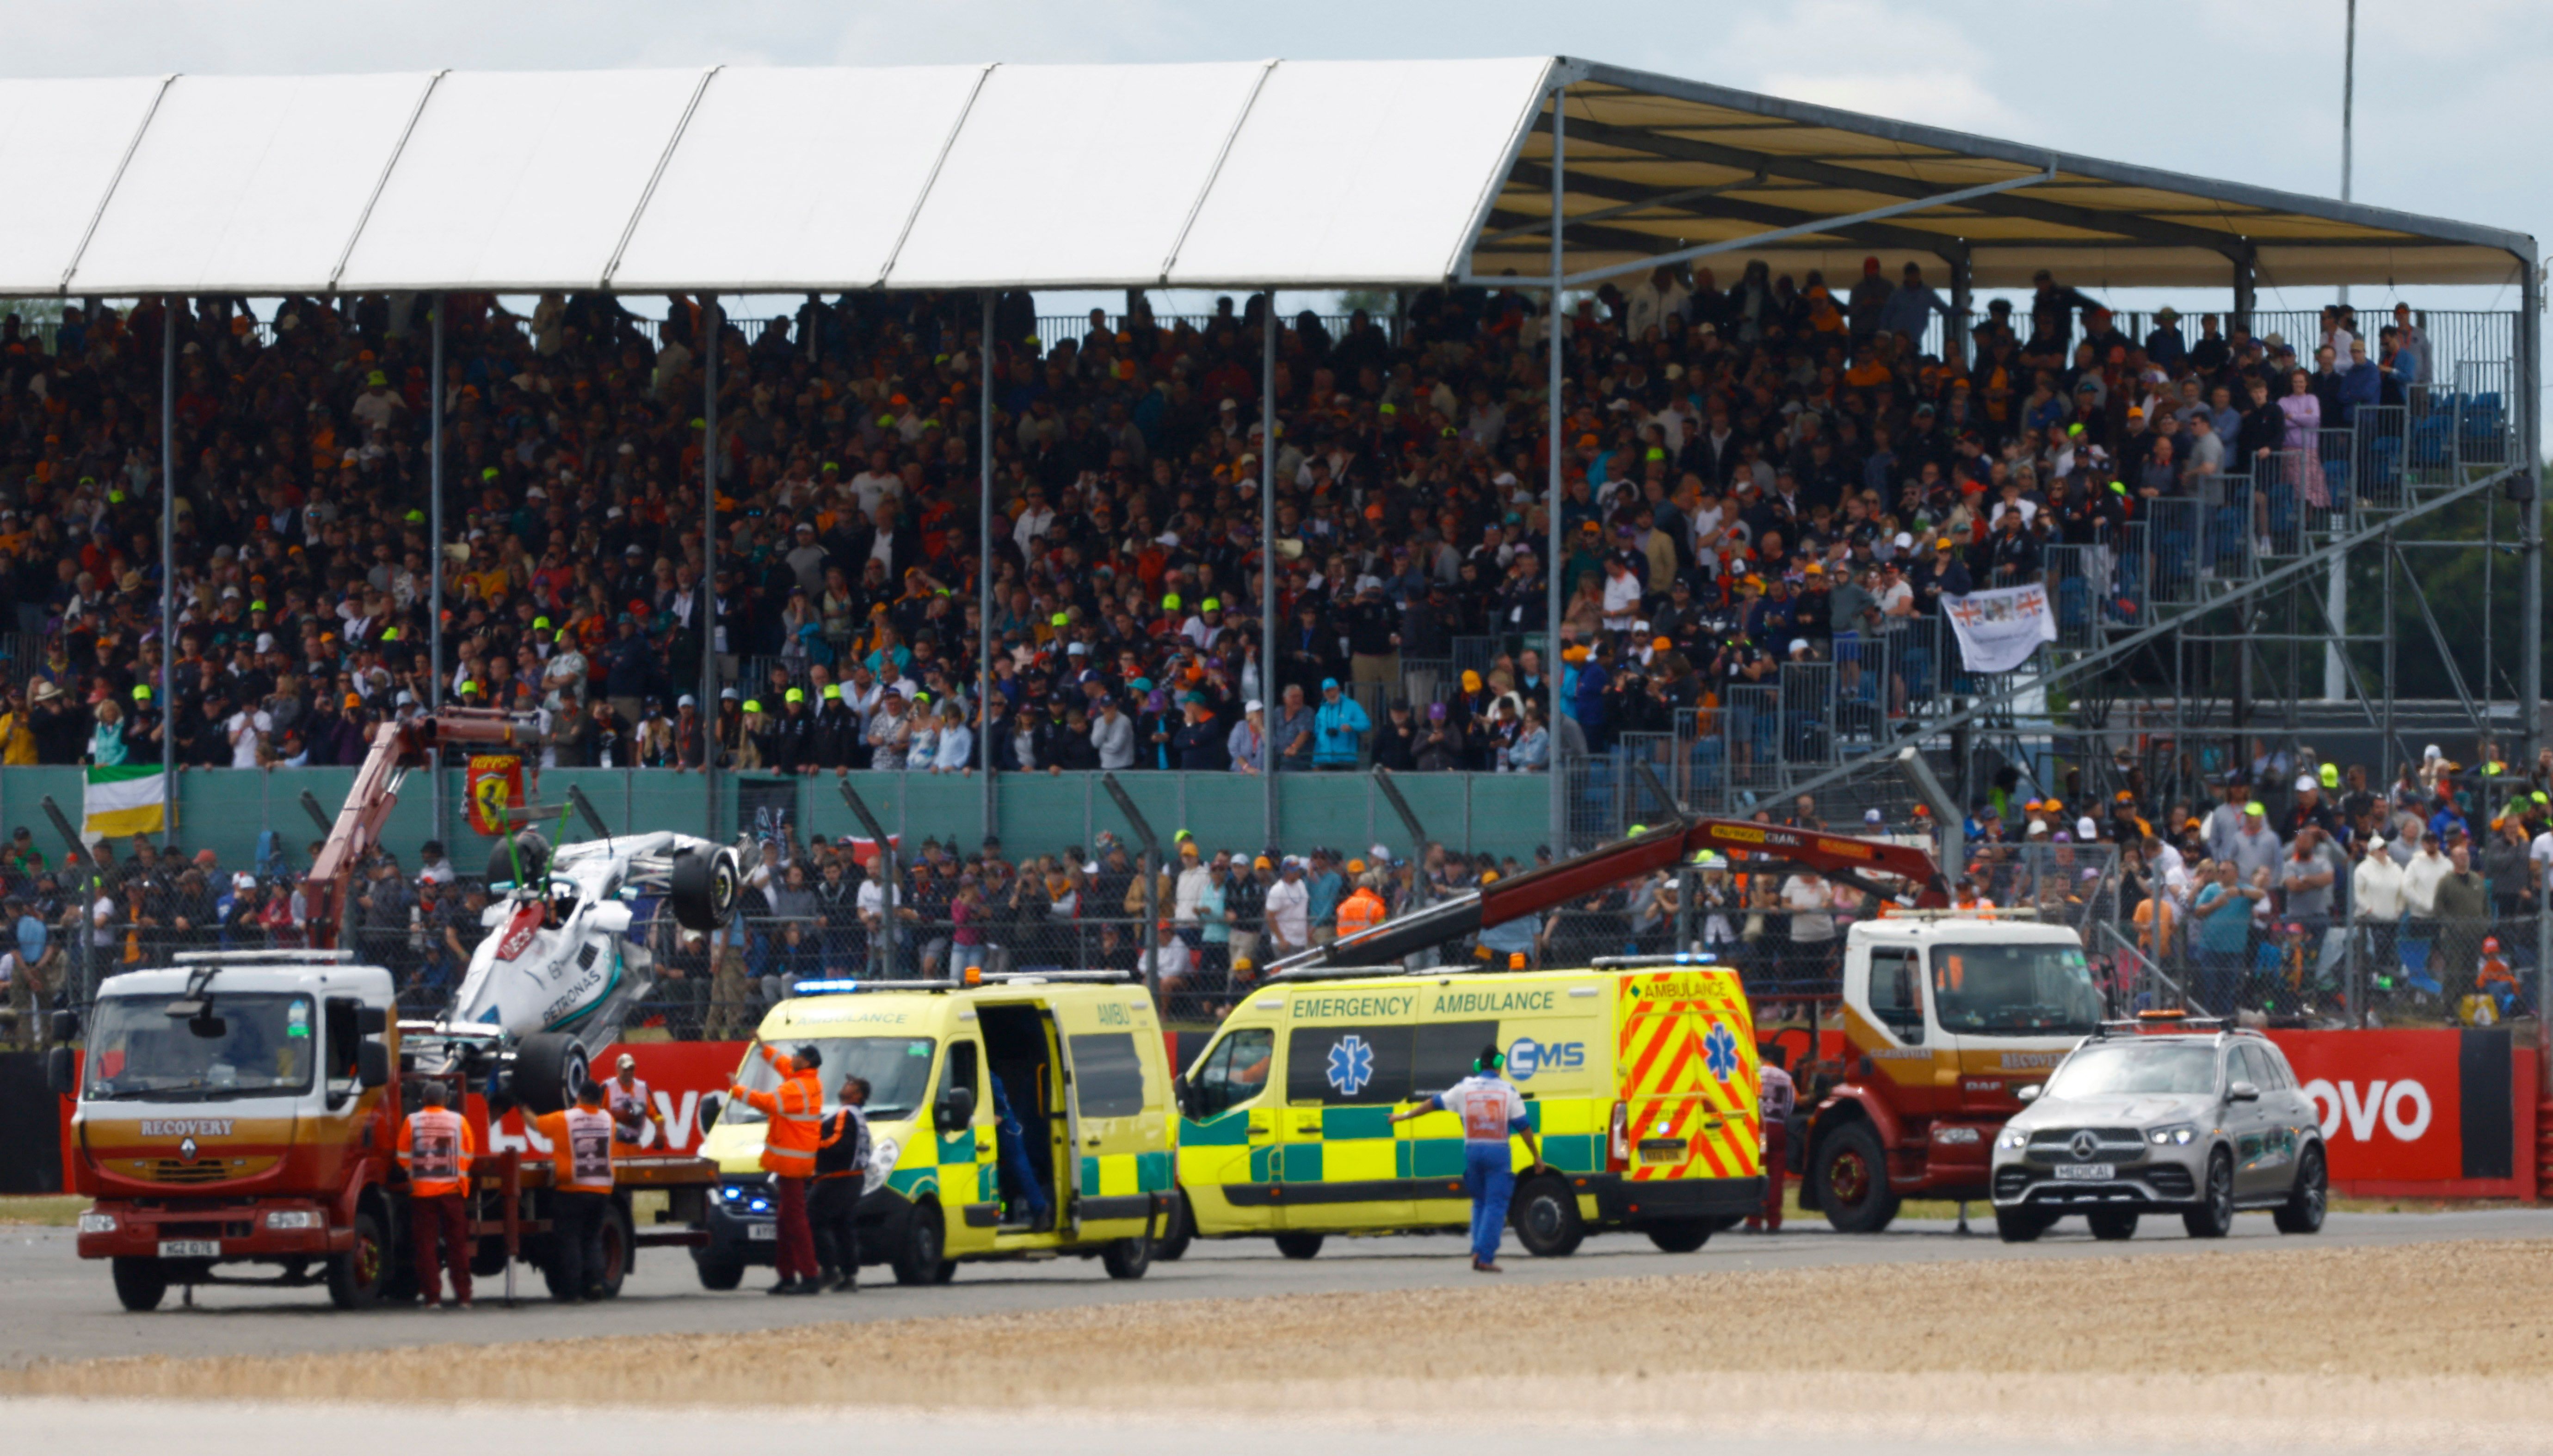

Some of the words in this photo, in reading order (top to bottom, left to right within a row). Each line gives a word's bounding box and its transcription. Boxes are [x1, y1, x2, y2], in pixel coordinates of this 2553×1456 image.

[543, 970, 601, 1021] PETRONAS
[1645, 981, 1727, 998] AMBULANCE
[1293, 996, 1414, 1018] EMERGENCY
[1434, 991, 1555, 1013] AMBULANCE
[796, 1013, 909, 1027] AMBULANCE
[1510, 1042, 1585, 1068] CMS
[2001, 1053, 2066, 1068] RECOVER
[1966, 1081, 2001, 1091] DAF
[140, 1118, 234, 1136] RECOVERY
[2060, 1165, 2110, 1178] MEDICAL
